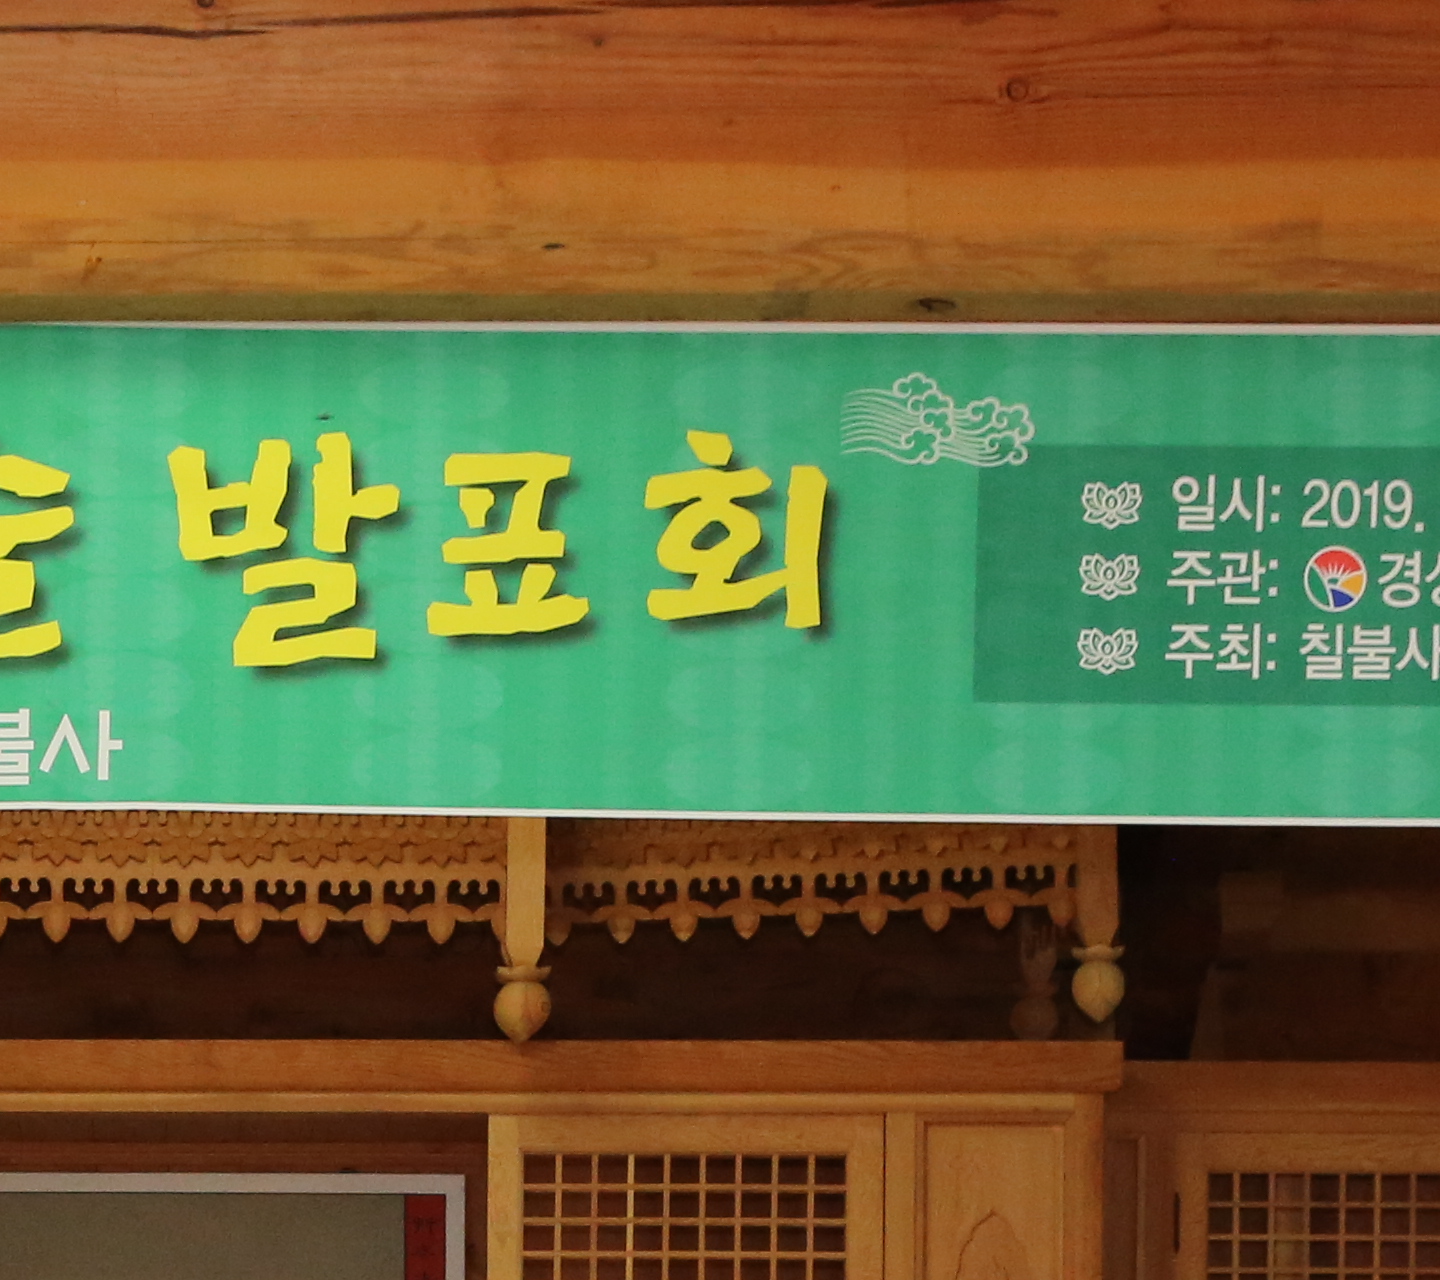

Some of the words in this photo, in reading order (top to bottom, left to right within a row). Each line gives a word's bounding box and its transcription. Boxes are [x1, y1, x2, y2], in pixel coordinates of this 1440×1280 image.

[1169, 477, 1281, 529] 일시:
[1301, 479, 1428, 532] 2019.
[165, 430, 829, 669] 발표회
[1166, 550, 1281, 605] 주관:
[1163, 623, 1280, 680] 주최:
